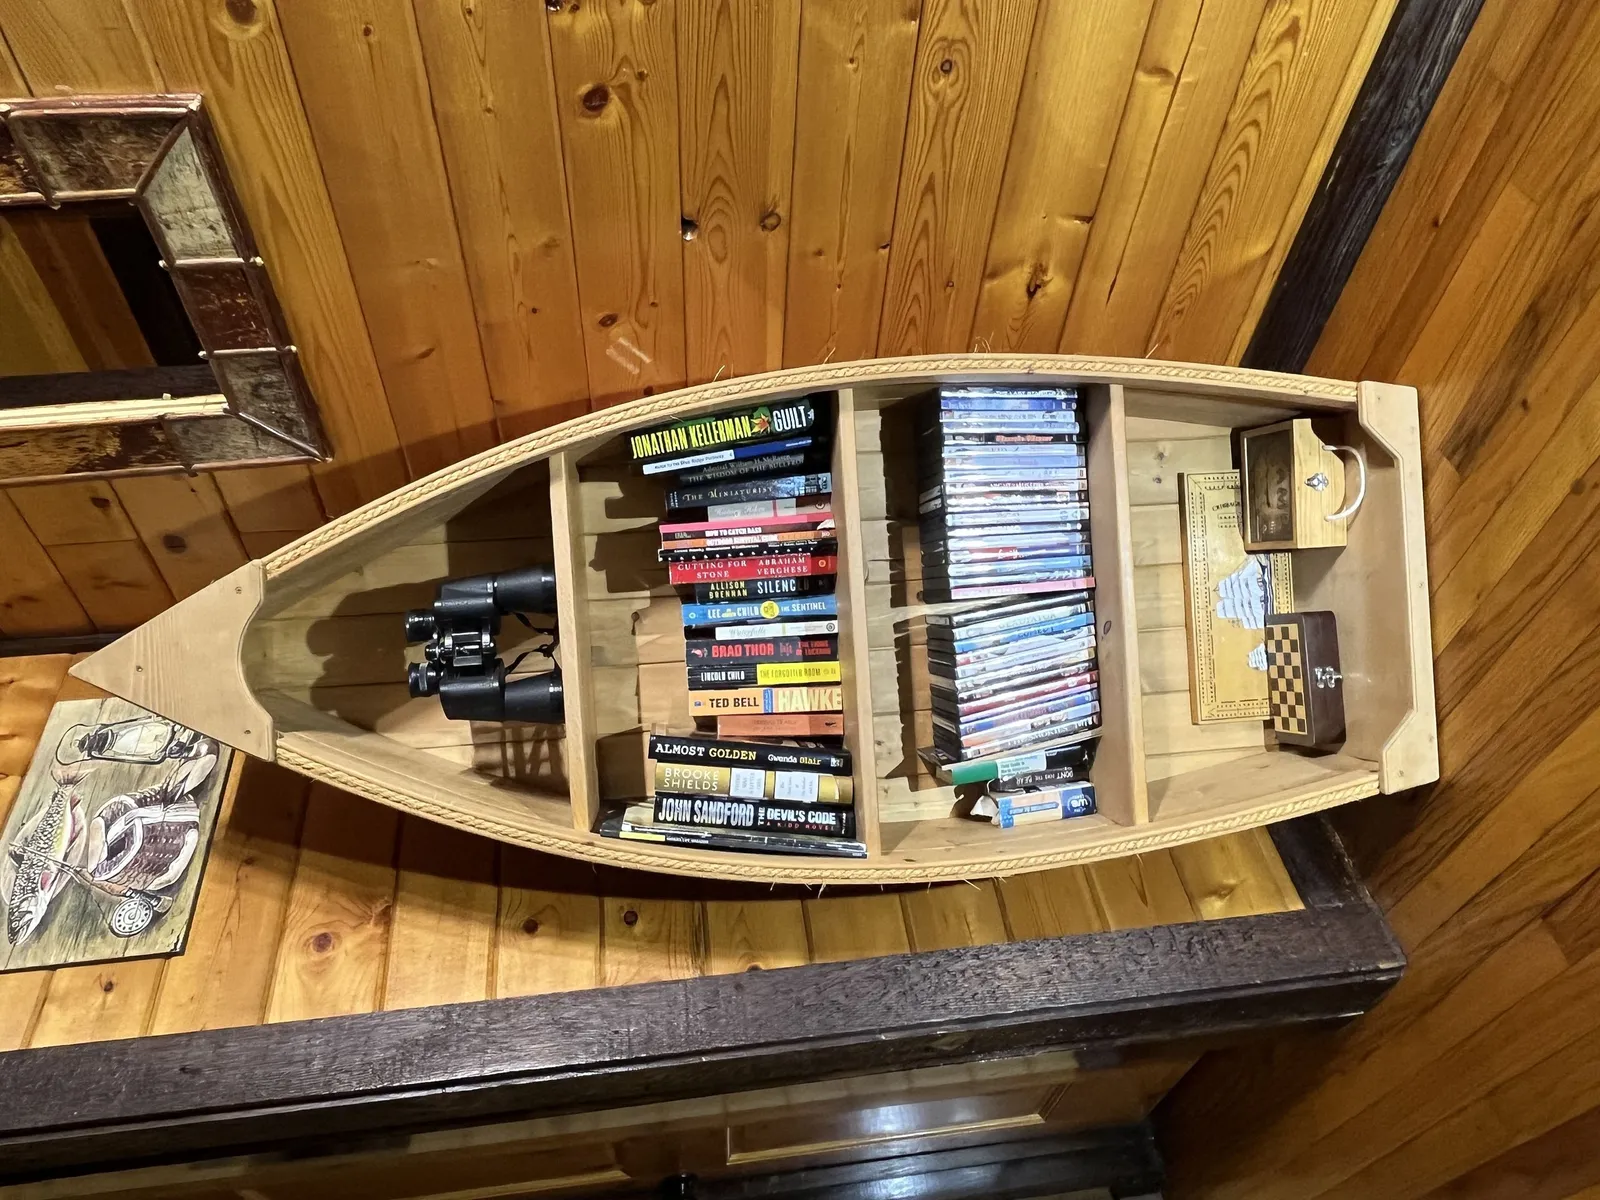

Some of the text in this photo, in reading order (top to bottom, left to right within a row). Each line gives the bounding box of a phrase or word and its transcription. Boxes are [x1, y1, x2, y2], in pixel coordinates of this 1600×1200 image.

[773, 405, 808, 432] GUILT
[630, 415, 752, 460] JONATHAN KELLERMAN
[688, 473, 704, 483] THE
[705, 469, 738, 482] WISDOM
[739, 466, 751, 475] OF
[751, 463, 767, 473] THE
[677, 560, 748, 572] CUTTING FOR
[758, 557, 806, 567] ABRAHAM
[696, 570, 730, 579] STONE
[757, 565, 809, 576] VERGHESE
[710, 580, 746, 591] ALLISON
[708, 589, 748, 600] BRENNAN
[707, 606, 760, 619] LEE CHILD
[791, 601, 827, 613] SENTINEL
[711, 642, 775, 658] BRAD THOR
[700, 670, 745, 682] LINCOLN CHILD
[760, 669, 771, 679] THE
[804, 667, 822, 677] ROOM
[709, 697, 730, 709] TED
[733, 696, 760, 708] BELL
[778, 688, 842, 713] HAWKE
[655, 743, 822, 766] ALMOST GOLDEN Gwenda Blair
[664, 767, 720, 782] BROOKE
[663, 777, 719, 792] SHIELDS
[658, 797, 755, 827] JOHN SANDFORD
[757, 806, 765, 826] THE
[766, 807, 806, 823] DEVIL'S
[807, 810, 837, 825] CODE
[777, 822, 800, 830] KIDD
